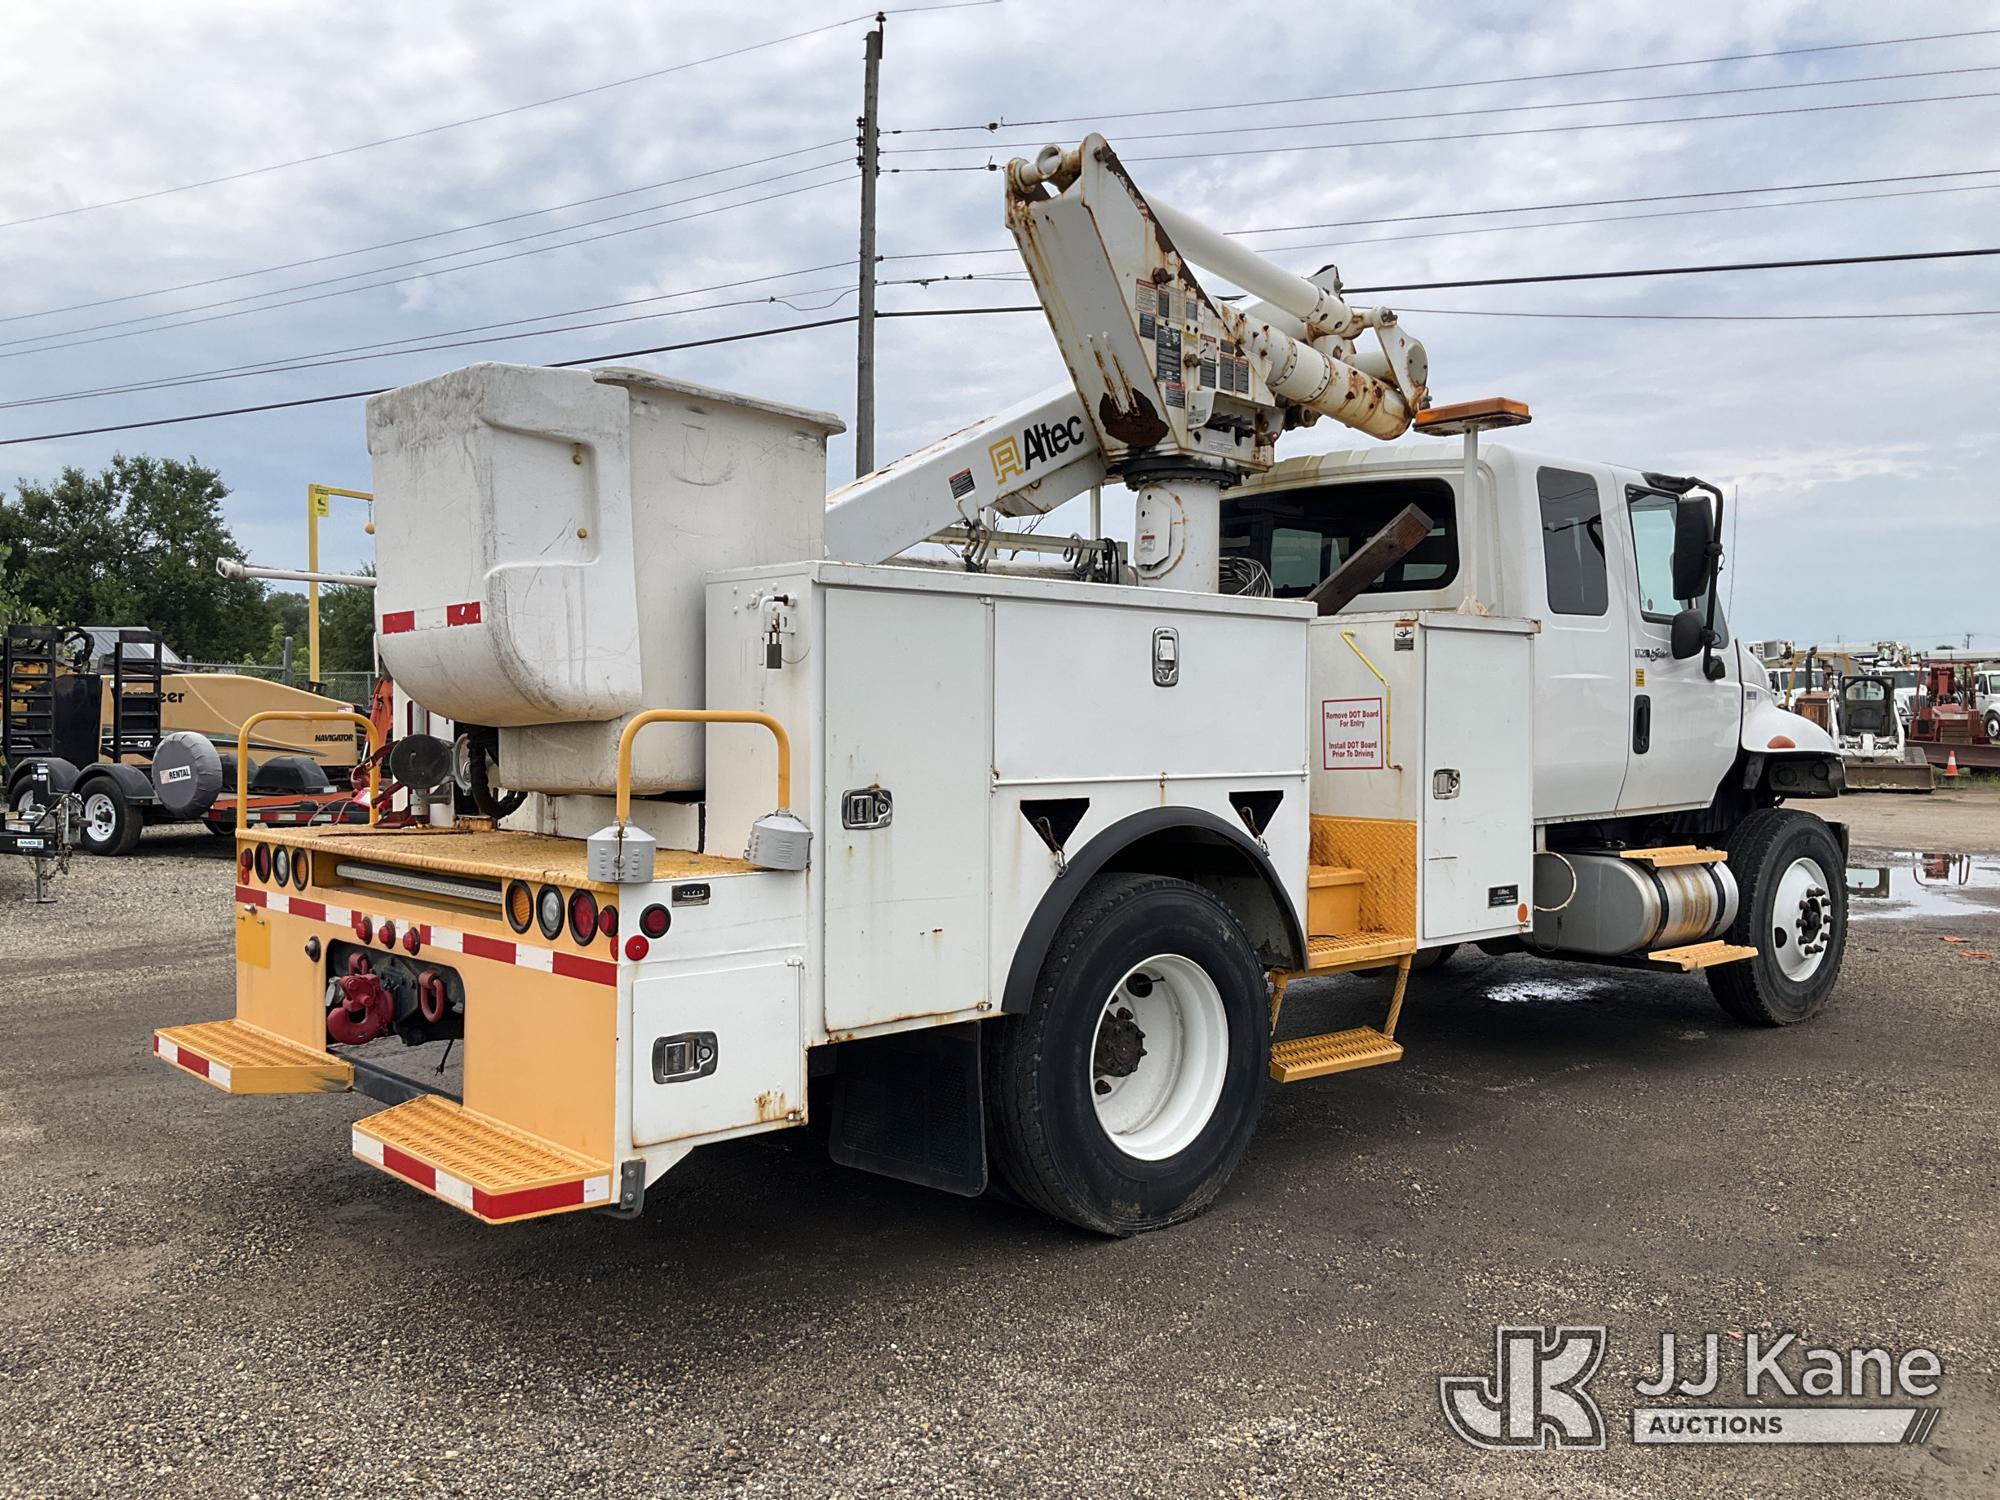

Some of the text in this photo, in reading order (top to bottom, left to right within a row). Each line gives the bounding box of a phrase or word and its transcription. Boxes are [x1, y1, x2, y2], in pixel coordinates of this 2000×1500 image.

[1024, 415, 1085, 471] Altec
[1362, 710, 1378, 718] Board
[1350, 720, 1365, 728] Entry
[314, 733, 354, 742] NAVIGATOR
[1329, 741, 1346, 749] Install
[1347, 741, 1359, 749] DOT
[1332, 750, 1374, 758] Prior To Driving
[168, 768, 190, 779] RENTAL
